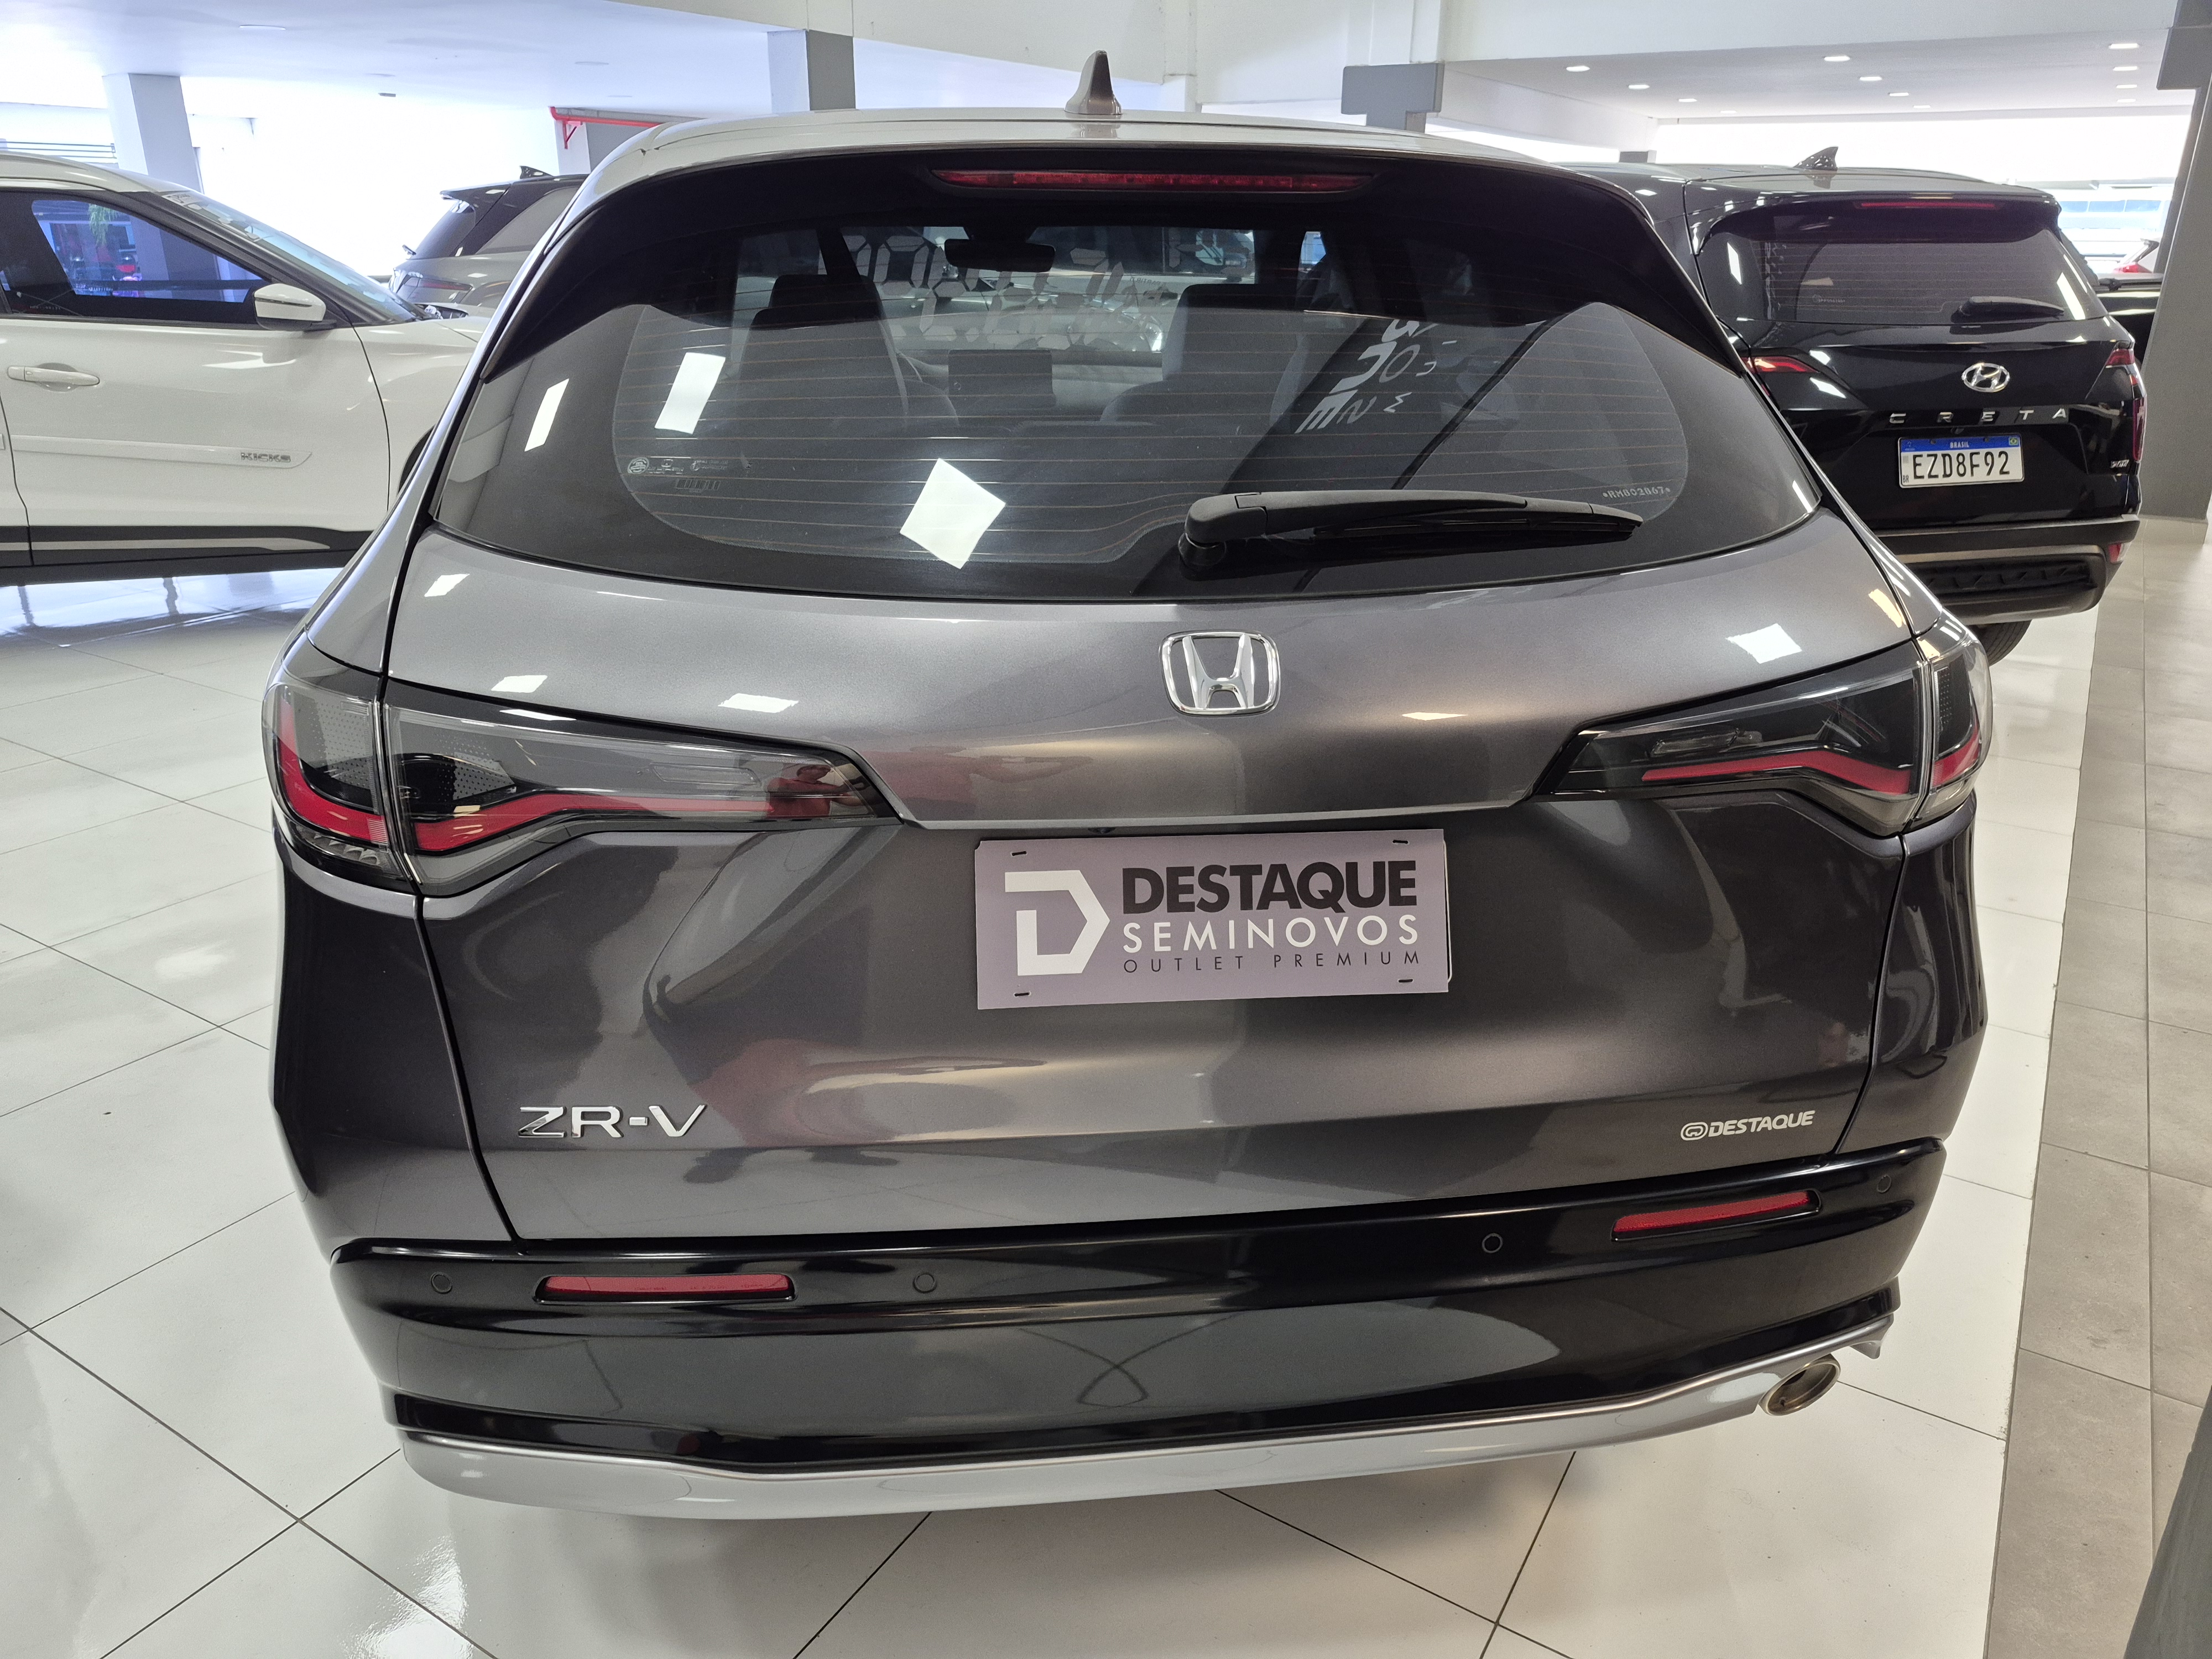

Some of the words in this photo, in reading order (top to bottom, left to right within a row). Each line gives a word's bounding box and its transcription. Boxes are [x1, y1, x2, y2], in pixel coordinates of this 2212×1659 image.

[1889, 408, 2067, 424] CRETA
[241, 452, 291, 462] KICKS
[1912, 451, 2010, 479] EZD8F92
[1902, 474, 1910, 483] BR
[1122, 860, 1417, 914] DESTAQUE
[1123, 914, 1418, 953] SEMINOVOS
[1123, 956, 1244, 973] OUTLET
[1273, 950, 1420, 968] PREMIUM
[518, 1104, 707, 1138] ZR-V
